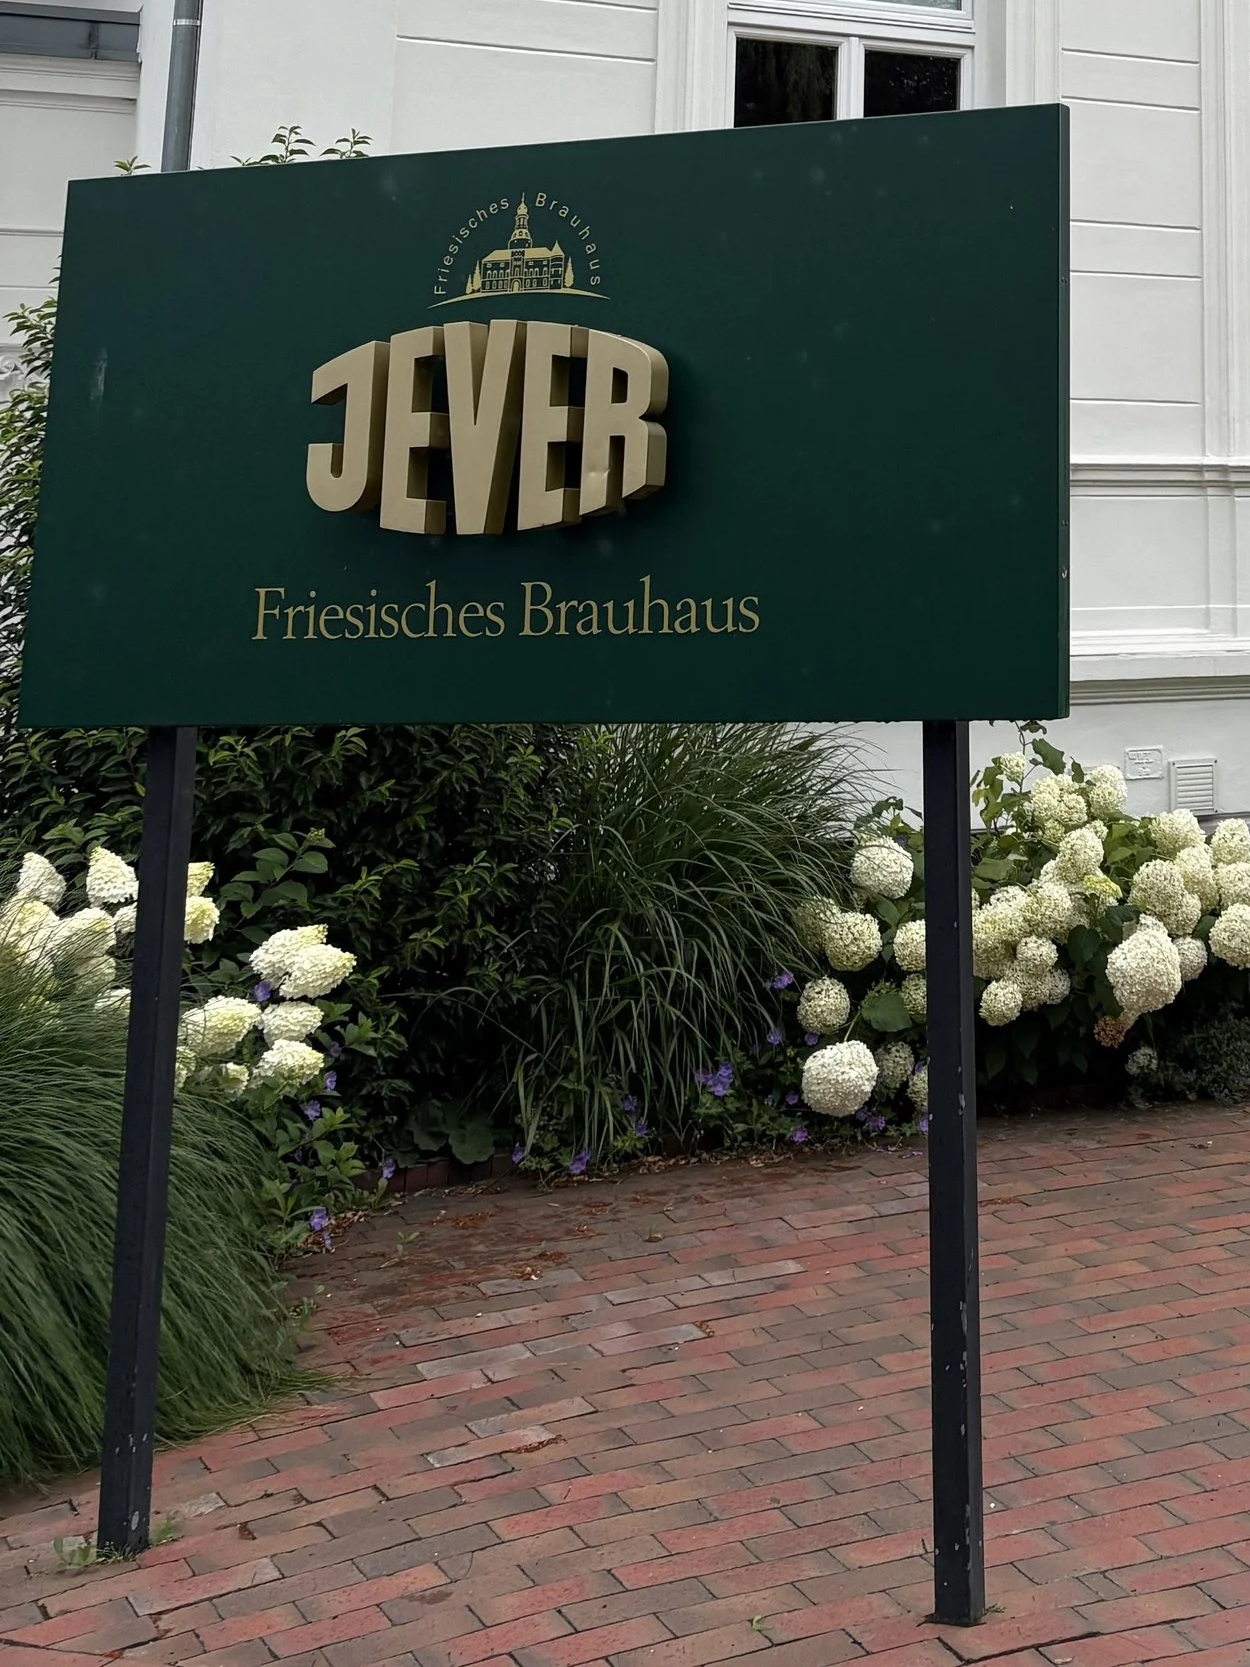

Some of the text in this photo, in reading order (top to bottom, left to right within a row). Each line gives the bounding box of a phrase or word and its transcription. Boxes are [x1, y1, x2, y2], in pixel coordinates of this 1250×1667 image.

[433, 192, 601, 295] Friesisches Brauhaus
[306, 319, 670, 535] JEVER
[251, 574, 761, 641] Friesisches Brauhaus
